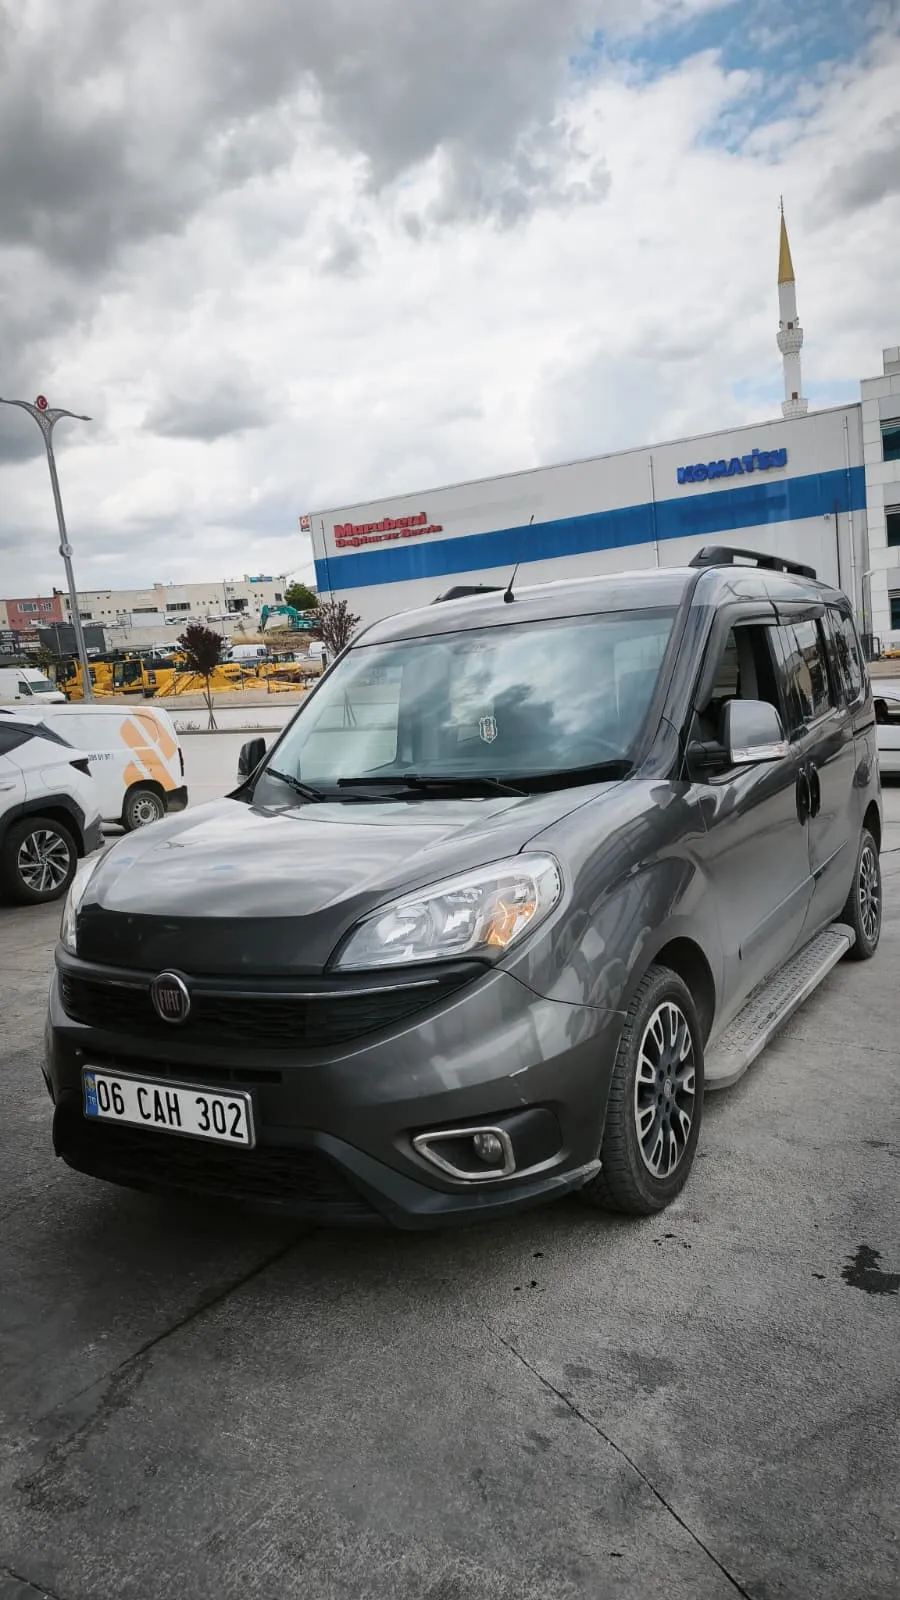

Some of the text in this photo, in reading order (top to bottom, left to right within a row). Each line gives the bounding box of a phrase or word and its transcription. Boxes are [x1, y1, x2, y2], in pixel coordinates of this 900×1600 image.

[676, 448, 788, 485] KOMATSU
[334, 511, 427, 538] Marubeni
[159, 989, 183, 1011] FIAT
[97, 1080, 125, 1115] 06
[137, 1087, 182, 1127] CAH
[195, 1097, 244, 1139] 302
